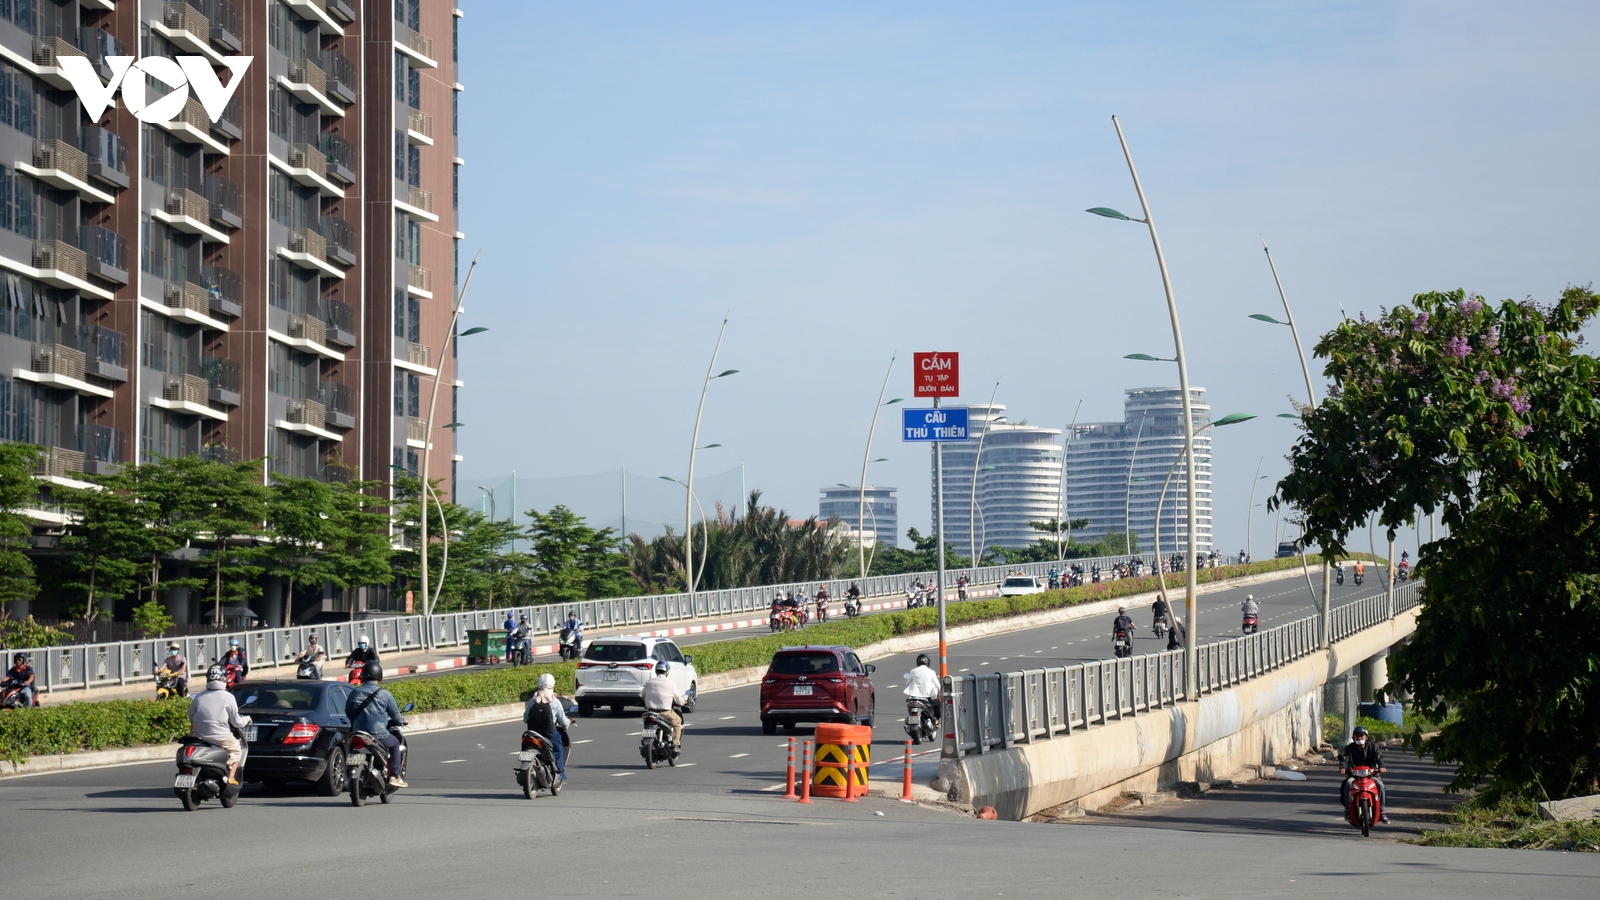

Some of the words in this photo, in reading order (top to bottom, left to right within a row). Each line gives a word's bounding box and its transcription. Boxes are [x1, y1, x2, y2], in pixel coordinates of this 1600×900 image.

[921, 353, 951, 371] CẤM
[924, 375, 934, 383] TỤ
[937, 373, 949, 383] TẬP
[918, 384, 936, 392] BUÔN
[940, 384, 955, 392] BÁN
[925, 410, 947, 424] CẦU
[905, 424, 928, 438] THỦ
[933, 424, 965, 438] THIÊM
